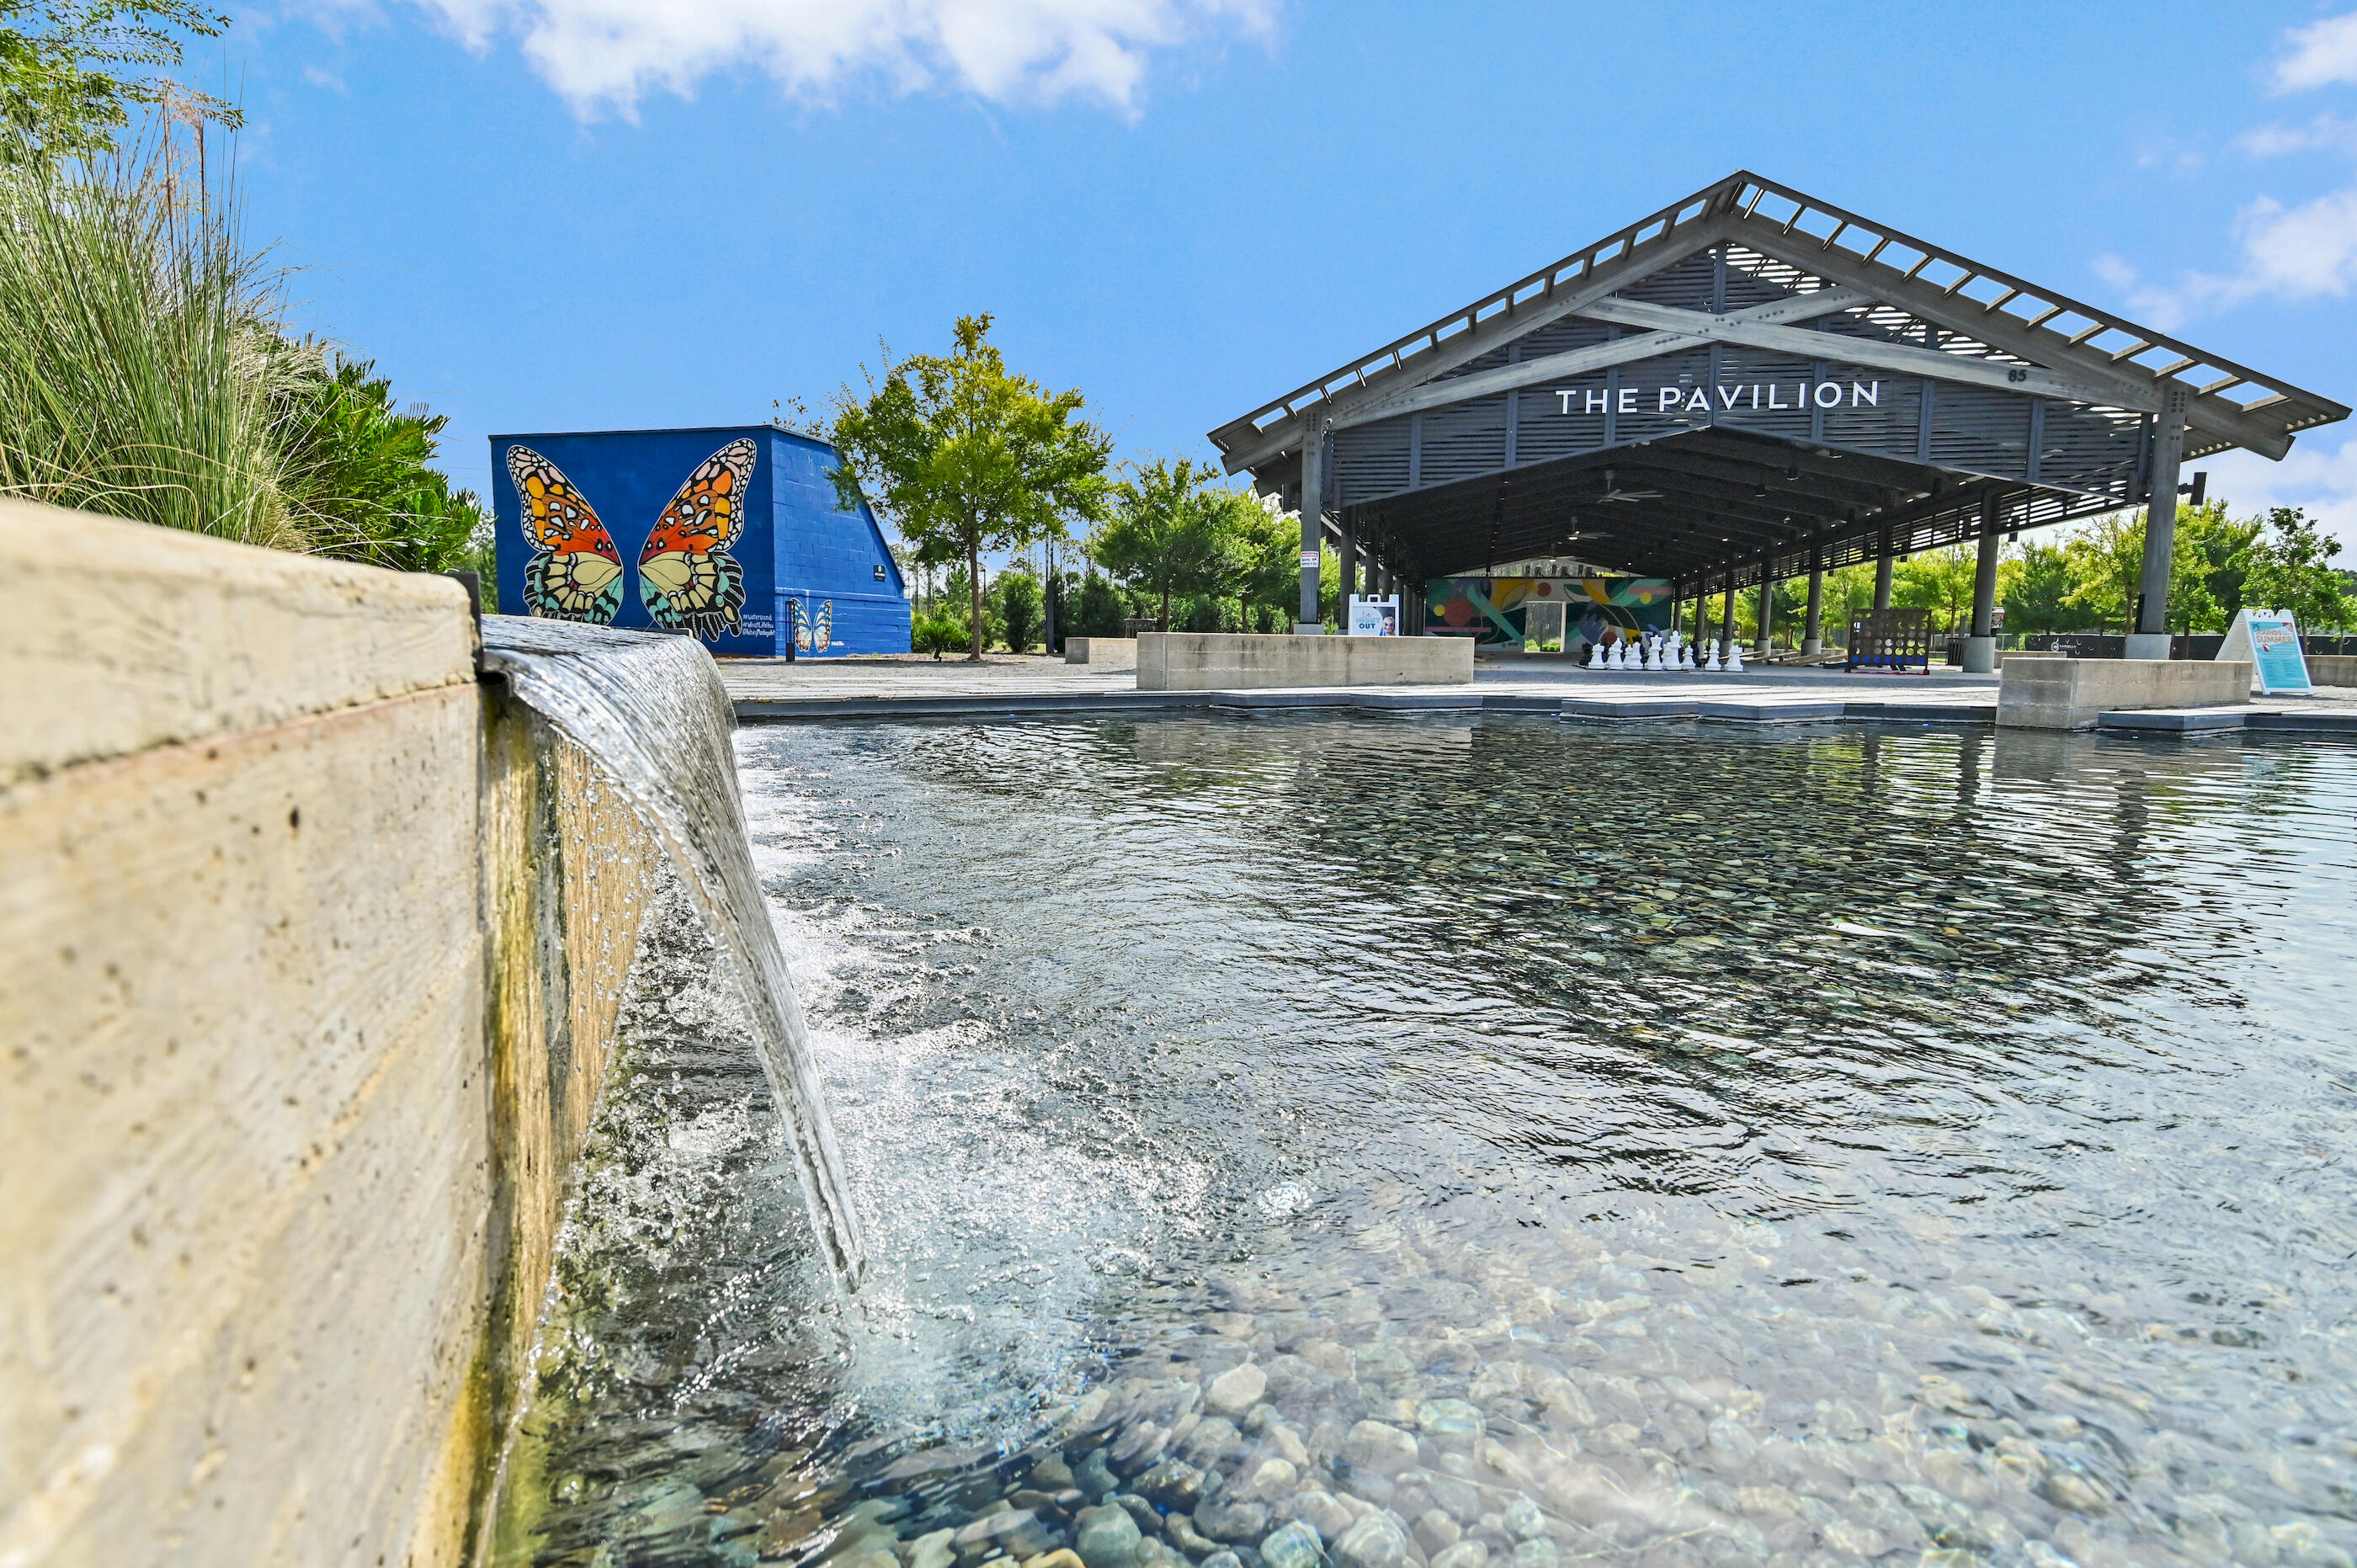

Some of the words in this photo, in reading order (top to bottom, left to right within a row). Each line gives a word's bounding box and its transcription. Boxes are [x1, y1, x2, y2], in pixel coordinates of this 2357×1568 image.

[2009, 369, 2027, 382] 85
[1556, 389, 1638, 414] THE
[1658, 380, 1878, 412] PAVILION
